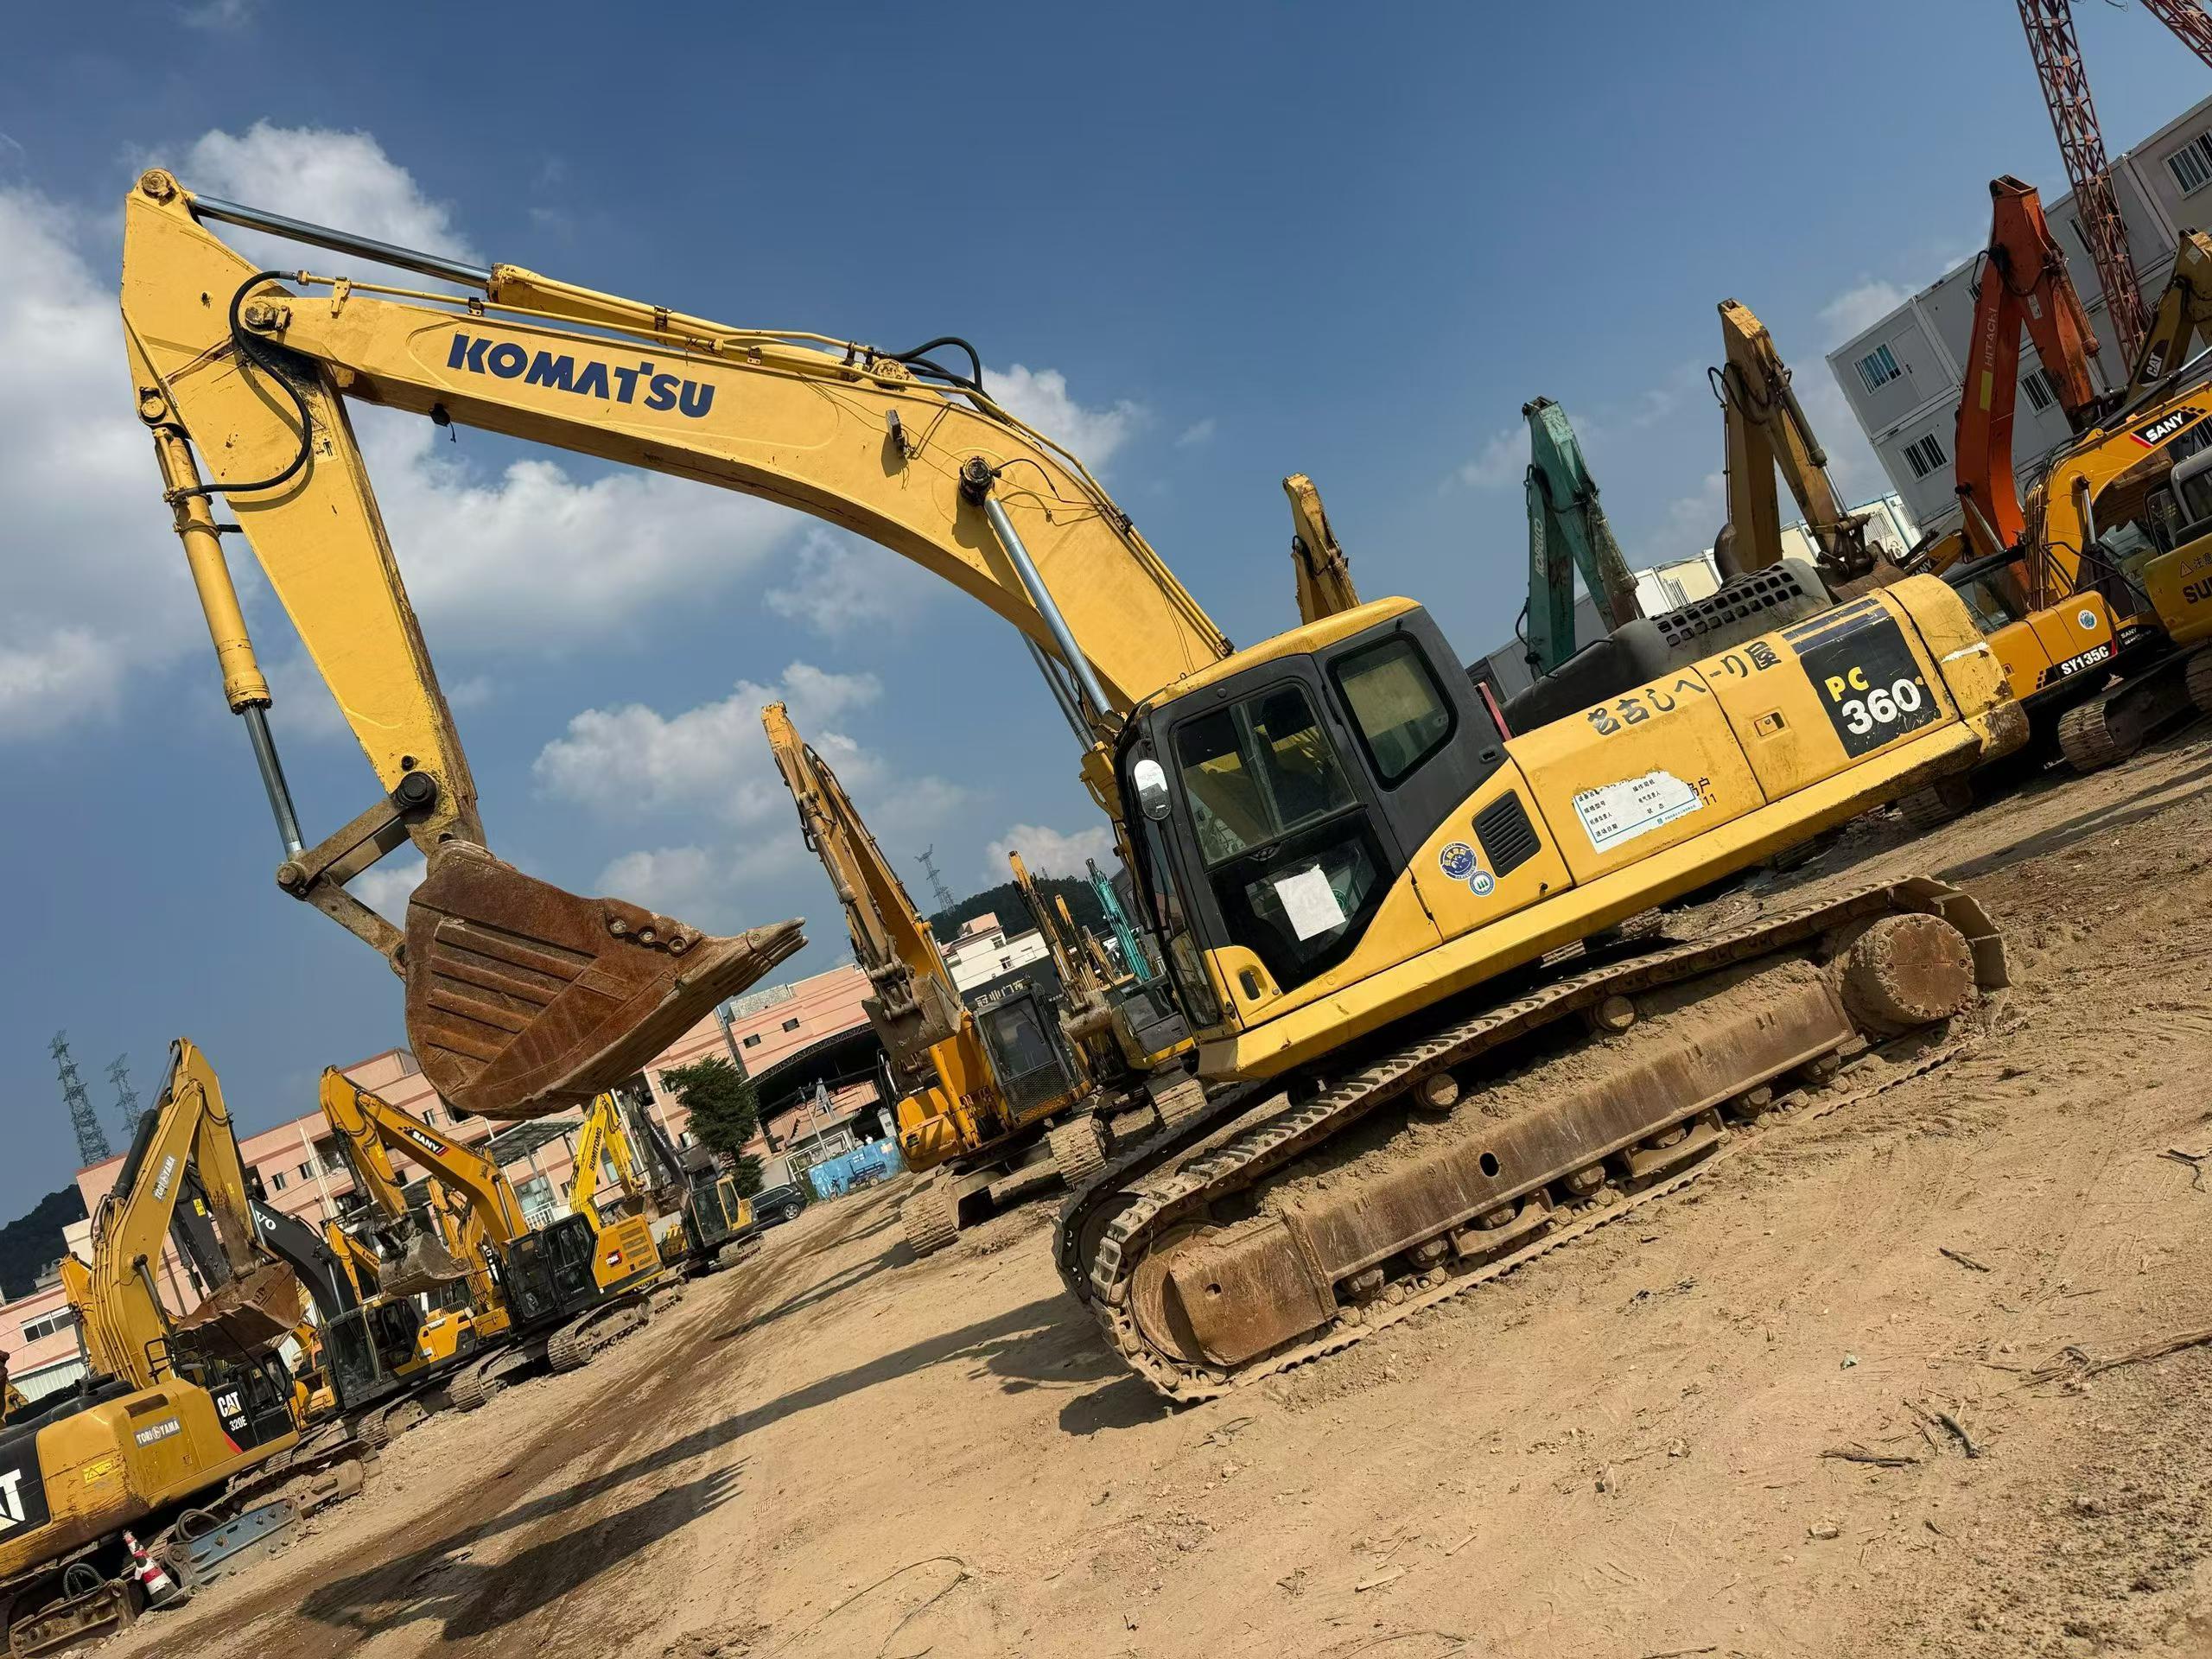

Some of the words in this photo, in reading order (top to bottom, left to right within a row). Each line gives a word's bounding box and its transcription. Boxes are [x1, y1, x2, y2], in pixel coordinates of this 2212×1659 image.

[1984, 308, 1998, 367] HITACHI
[447, 334, 715, 419] KOMATSU
[2146, 352, 2163, 378] CAT
[2145, 412, 2183, 442] SANY
[1912, 559, 1932, 576] ANY
[2120, 627, 2138, 639] SANY
[2061, 645, 2109, 675] SY135C
[1824, 666, 1870, 702] PC
[1841, 677, 1922, 736] 360
[412, 1130, 439, 1152] SANY
[588, 1127, 602, 1171] SUMITOMO
[217, 1391, 242, 1417] CAT
[160, 1420, 180, 1436] YAMA
[229, 1415, 247, 1432] 320E
[0, 1469, 25, 1522] T
